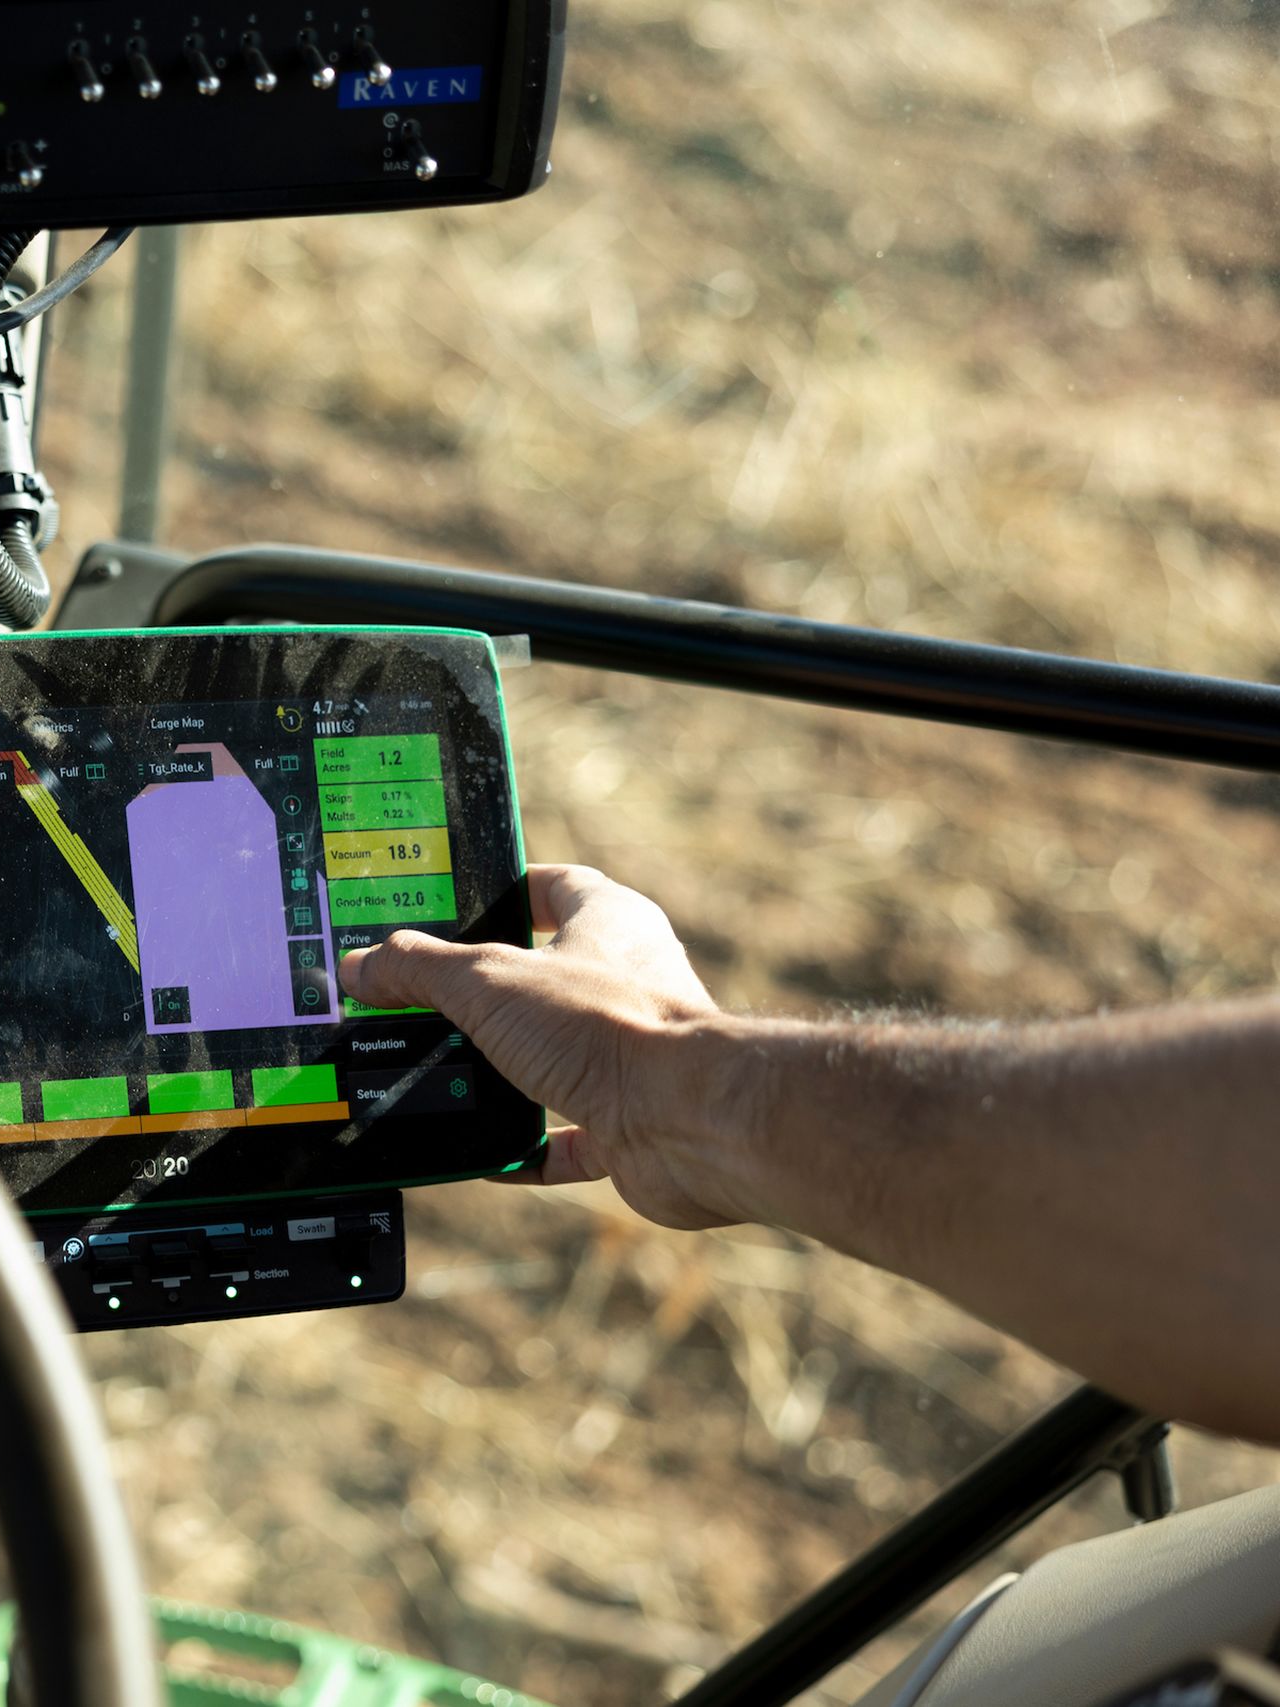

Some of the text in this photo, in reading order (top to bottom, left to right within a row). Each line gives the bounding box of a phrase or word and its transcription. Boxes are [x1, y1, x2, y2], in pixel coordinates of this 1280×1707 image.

[353, 76, 468, 102] RAVEN
[313, 700, 333, 714] 4.7
[150, 717, 204, 731] Large Map
[288, 715, 294, 726] 1
[35, 722, 74, 733] Metrics
[320, 748, 345, 759] Field
[378, 750, 402, 766] 1.2
[149, 761, 205, 775] Tgt_Rate_k
[255, 758, 273, 769] Full
[322, 763, 351, 773] Acres
[60, 766, 79, 777] Full
[325, 793, 352, 805] Skips
[327, 811, 356, 822] Mults
[383, 809, 403, 819] 0.22
[330, 843, 421, 860] Vacuum 18.9
[336, 897, 362, 908] Good
[365, 895, 386, 906] Ride
[393, 891, 425, 907] 92.0
[168, 1001, 180, 1010] On
[352, 1039, 406, 1052] Population
[357, 1089, 387, 1101] Setup
[250, 1226, 273, 1237] Load
[297, 1223, 326, 1235] Swath
[254, 1268, 289, 1280] Section
